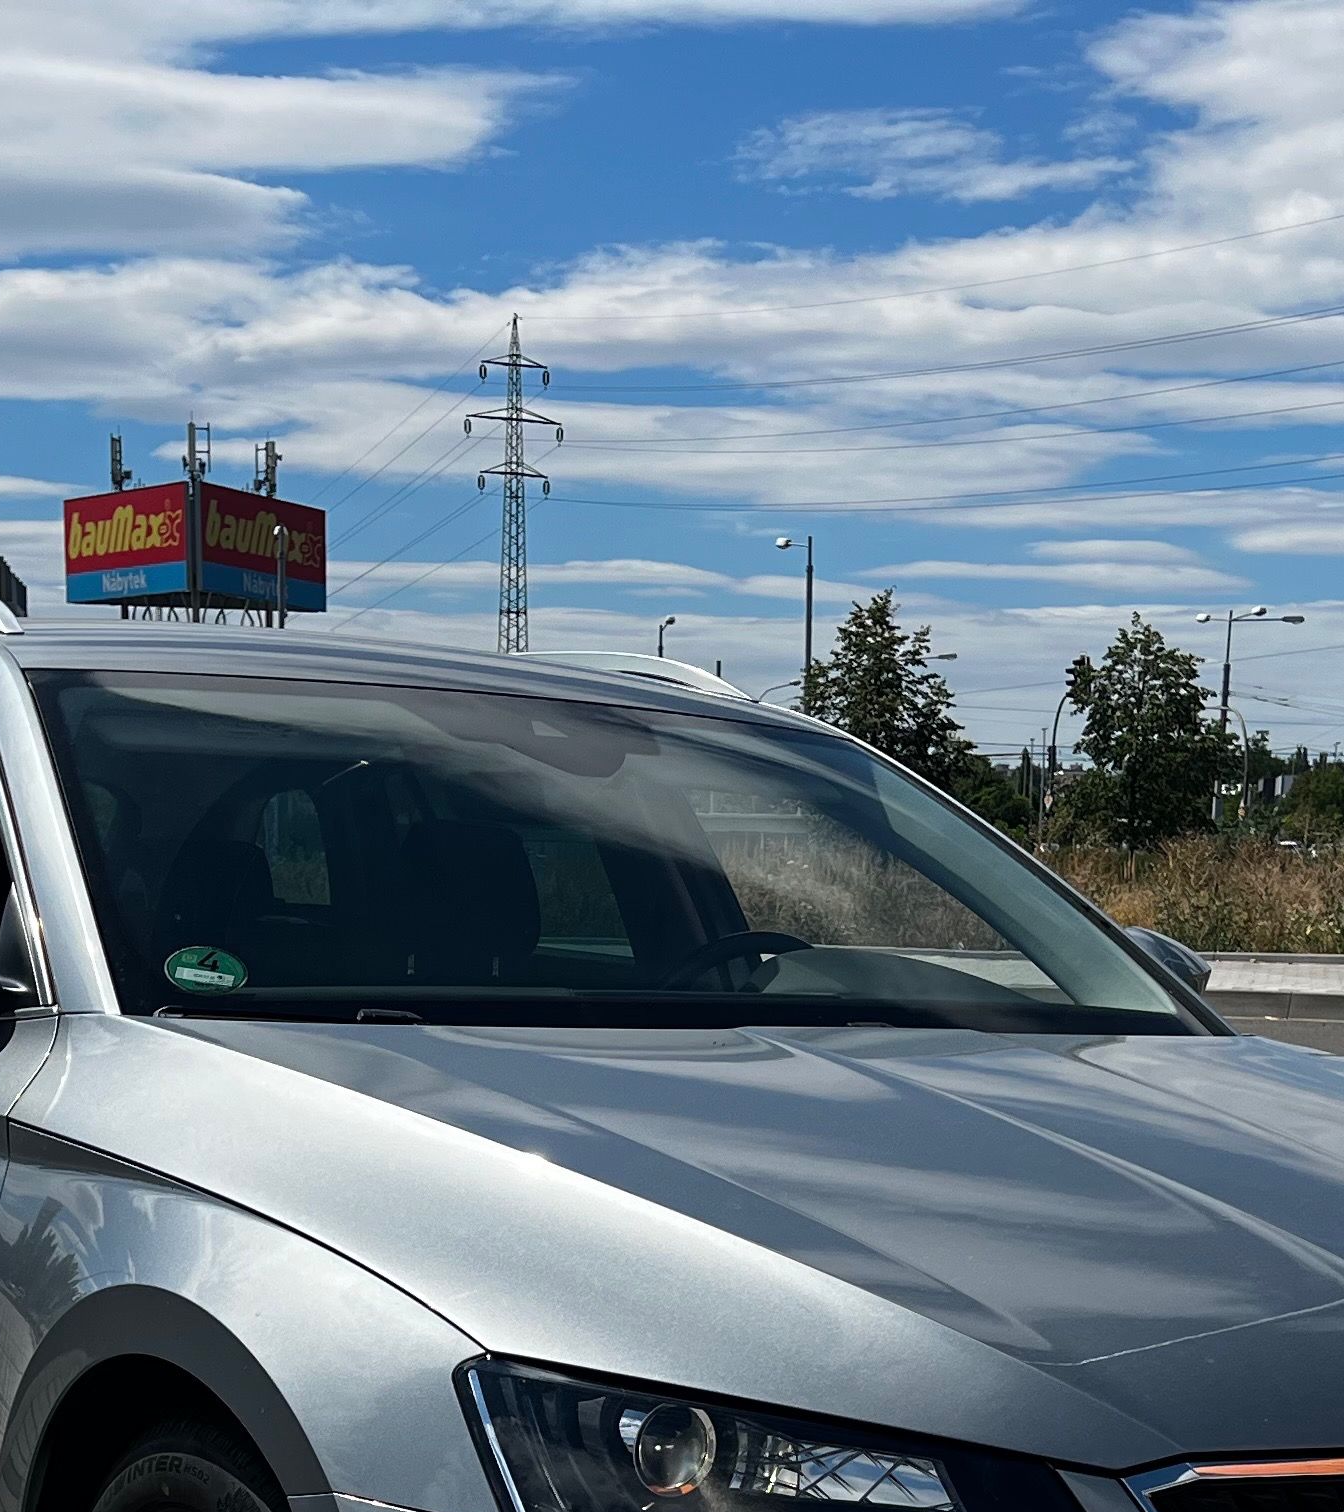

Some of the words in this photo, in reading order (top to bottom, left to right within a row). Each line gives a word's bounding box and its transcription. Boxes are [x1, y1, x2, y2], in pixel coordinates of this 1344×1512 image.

[102, 569, 147, 594] Nábytek
[242, 572, 289, 600] Nábyt
[196, 951, 220, 971] 4
